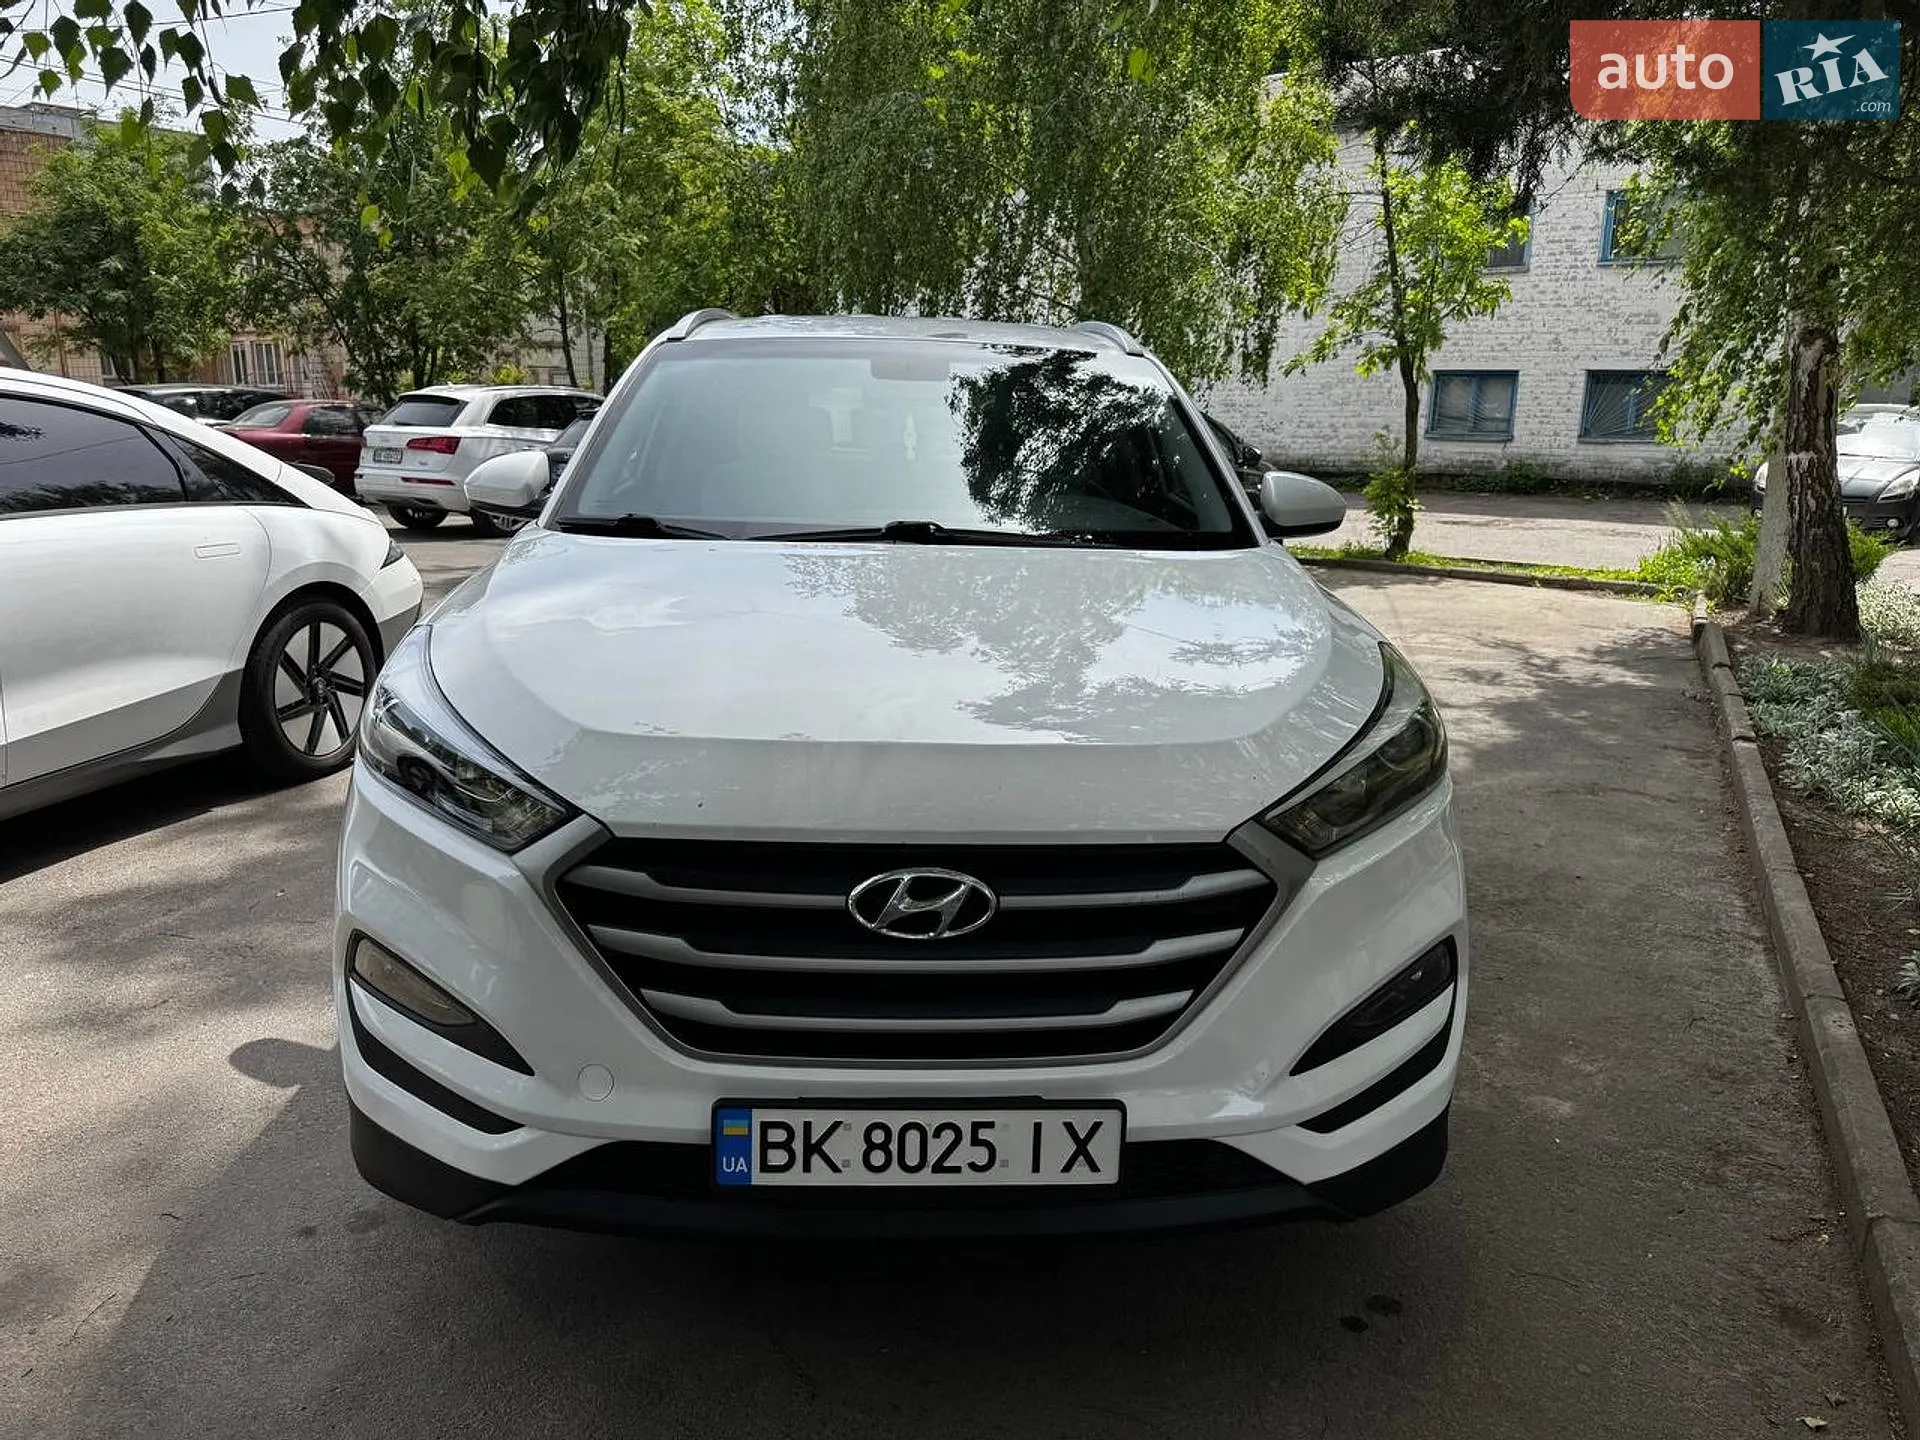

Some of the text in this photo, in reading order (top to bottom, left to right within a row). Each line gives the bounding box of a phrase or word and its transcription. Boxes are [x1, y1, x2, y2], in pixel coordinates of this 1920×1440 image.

[722, 1157, 748, 1173] UA
[759, 1120, 1104, 1175] BK 8025 IX
